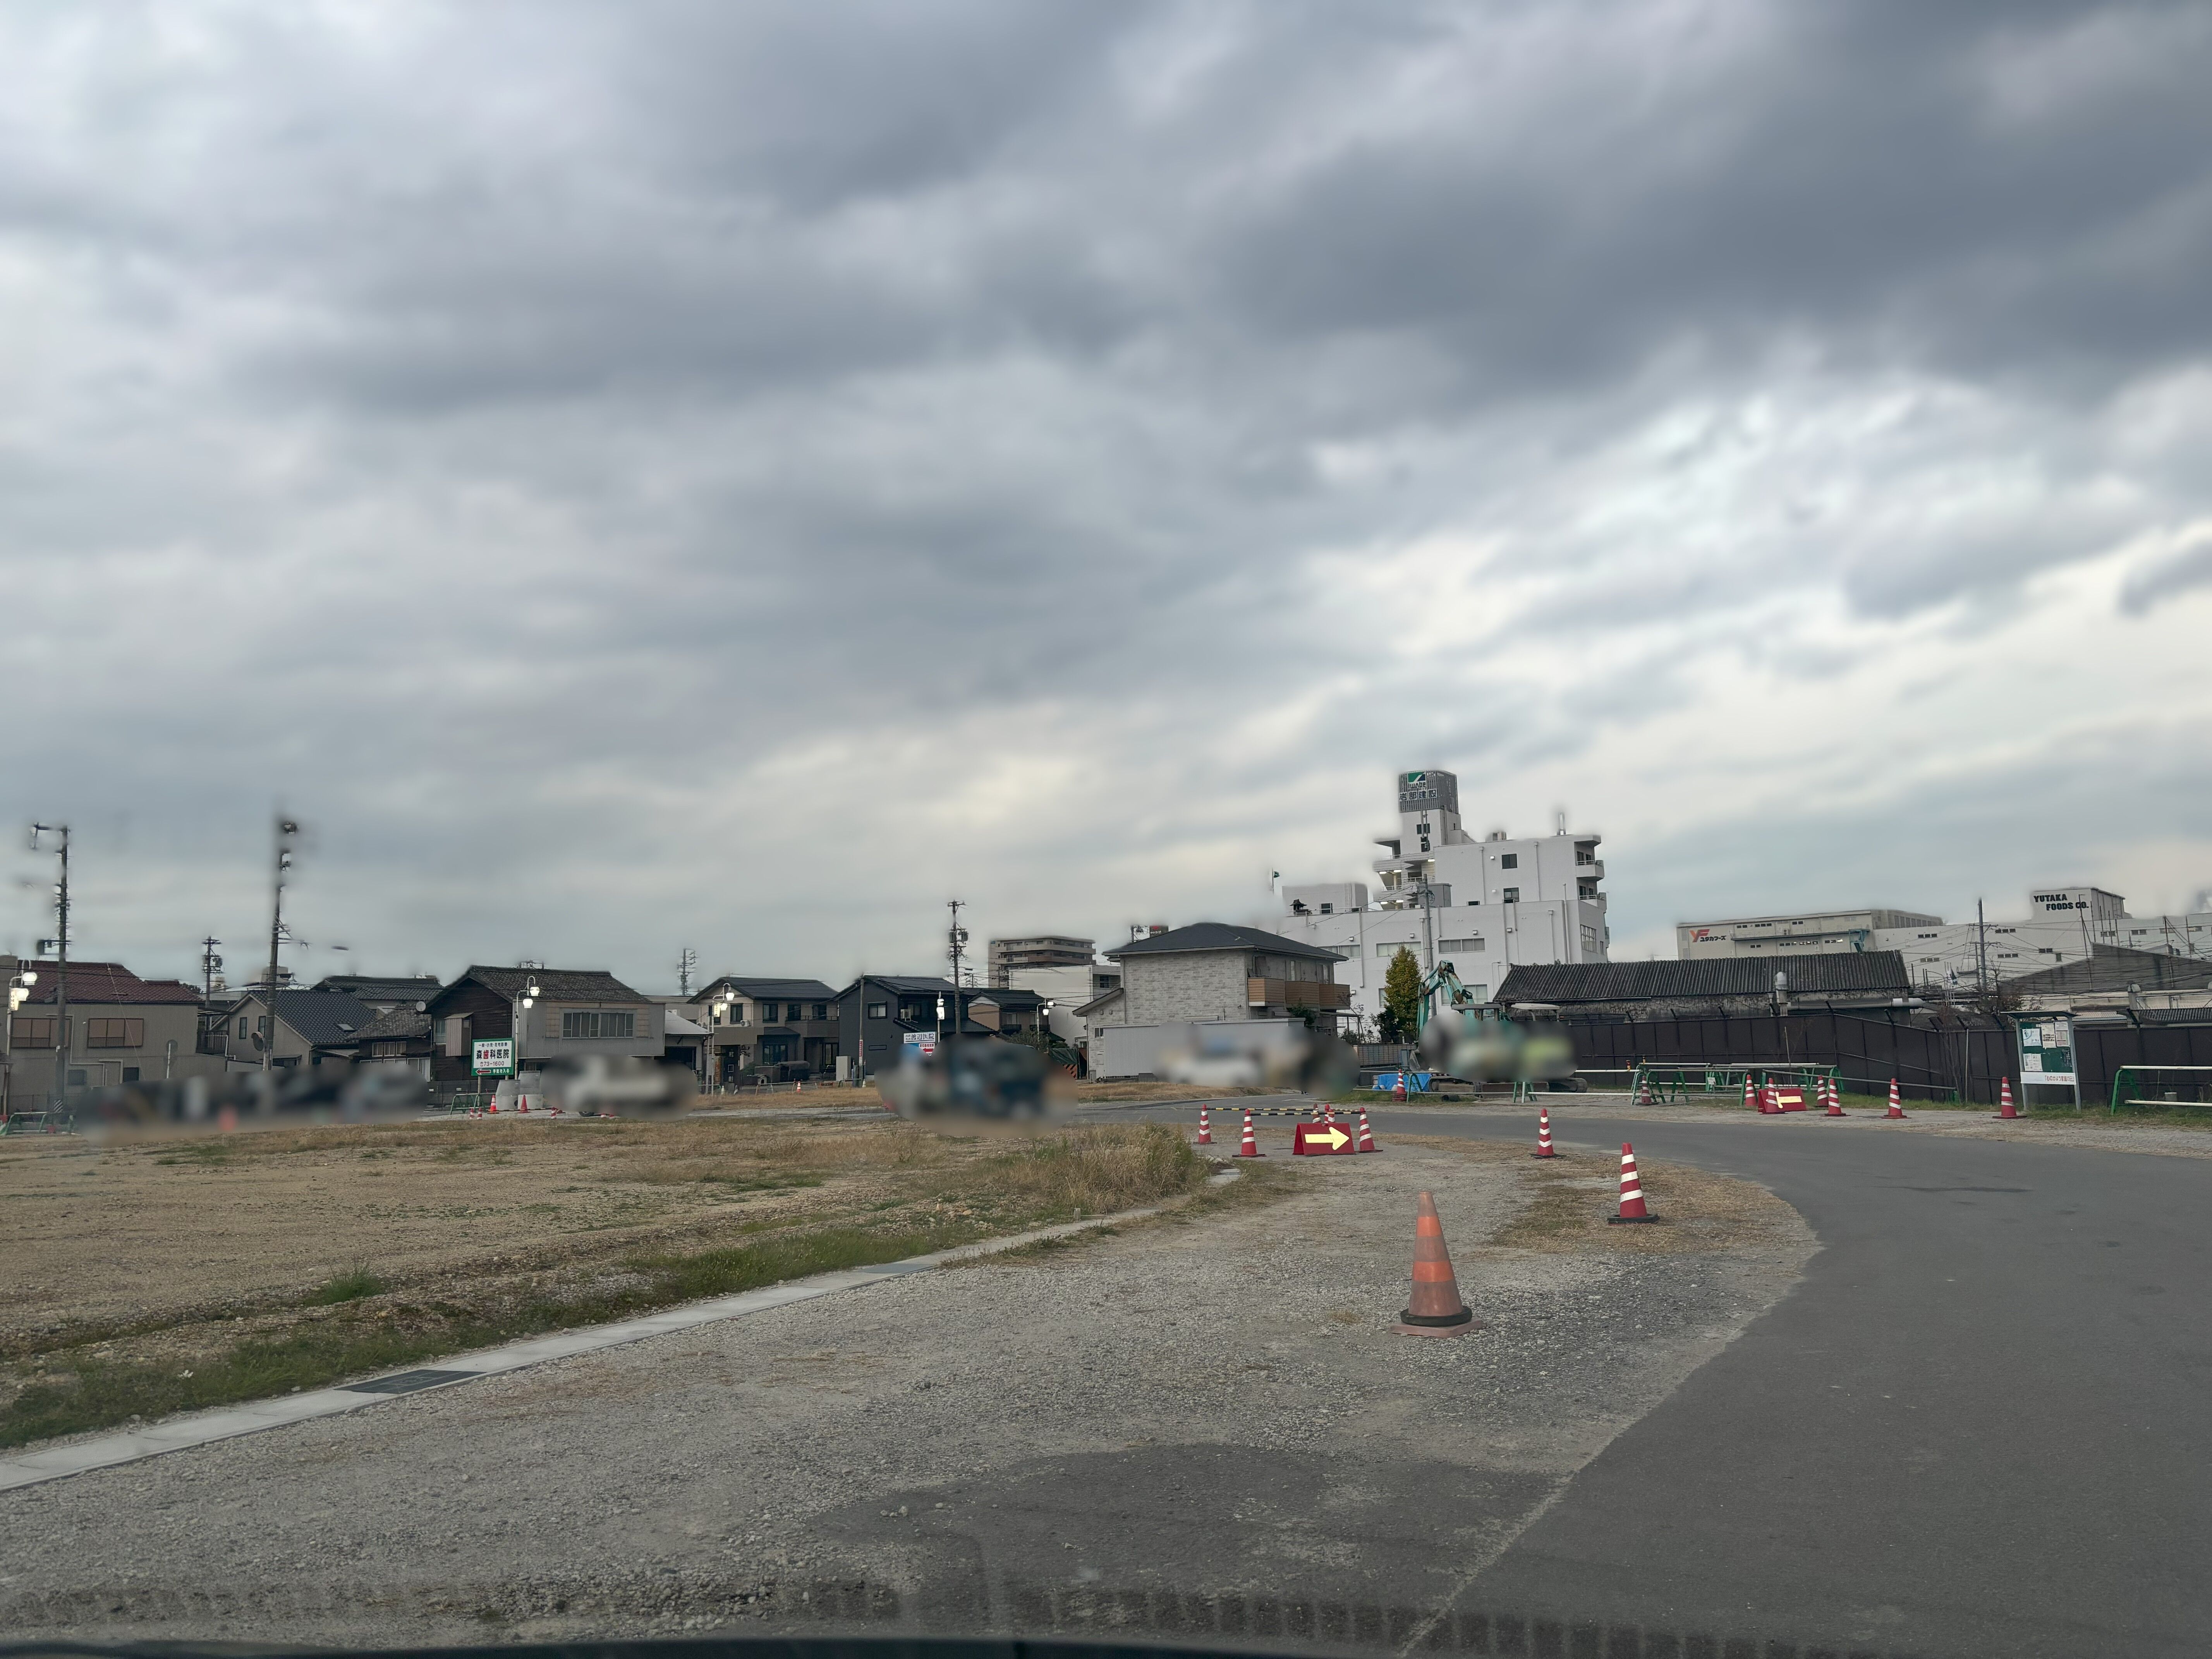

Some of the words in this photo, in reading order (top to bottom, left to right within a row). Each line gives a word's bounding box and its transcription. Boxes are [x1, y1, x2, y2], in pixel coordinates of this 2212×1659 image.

[1399, 789, 1437, 801] 岩部建設
[2033, 894, 2068, 903] YUTAKA
[2046, 902, 2074, 911] FOODS
[476, 1049, 509, 1060] 森歯科医院
